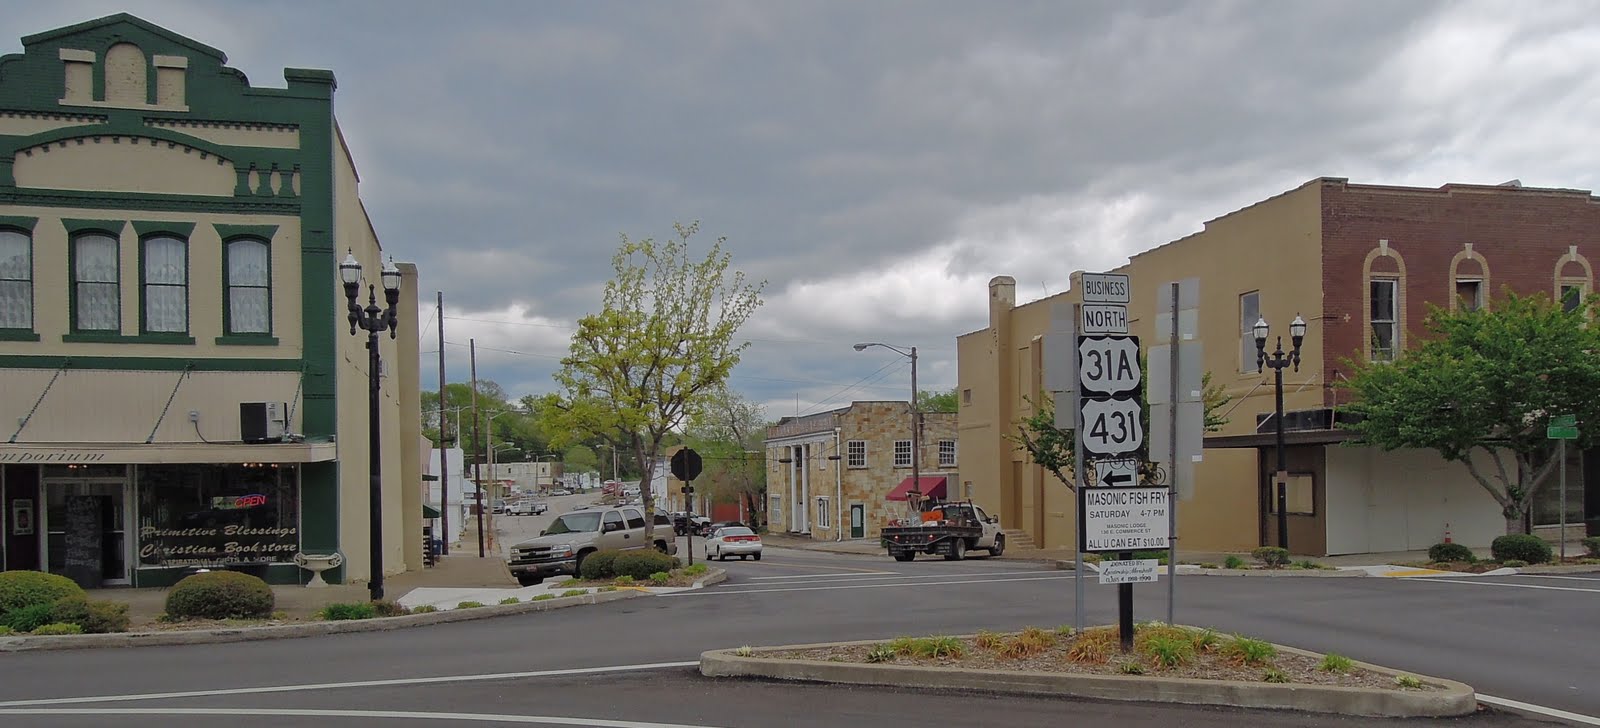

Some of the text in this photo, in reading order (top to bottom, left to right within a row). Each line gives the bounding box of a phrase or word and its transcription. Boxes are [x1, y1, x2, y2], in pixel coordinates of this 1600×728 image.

[1086, 281, 1125, 296] BUSINESS
[1085, 311, 1126, 327] NORTH
[1086, 349, 1134, 381] 31A
[1090, 411, 1136, 444] 431
[234, 495, 266, 508] OPEN
[1088, 492, 1166, 505] MASONIC FISH FRY
[1140, 509, 1152, 517] 4-7
[140, 524, 296, 538] Primitive Blessings
[139, 542, 217, 558] Christian
[1088, 537, 1164, 549] ALL U CAN EAT $10.00
